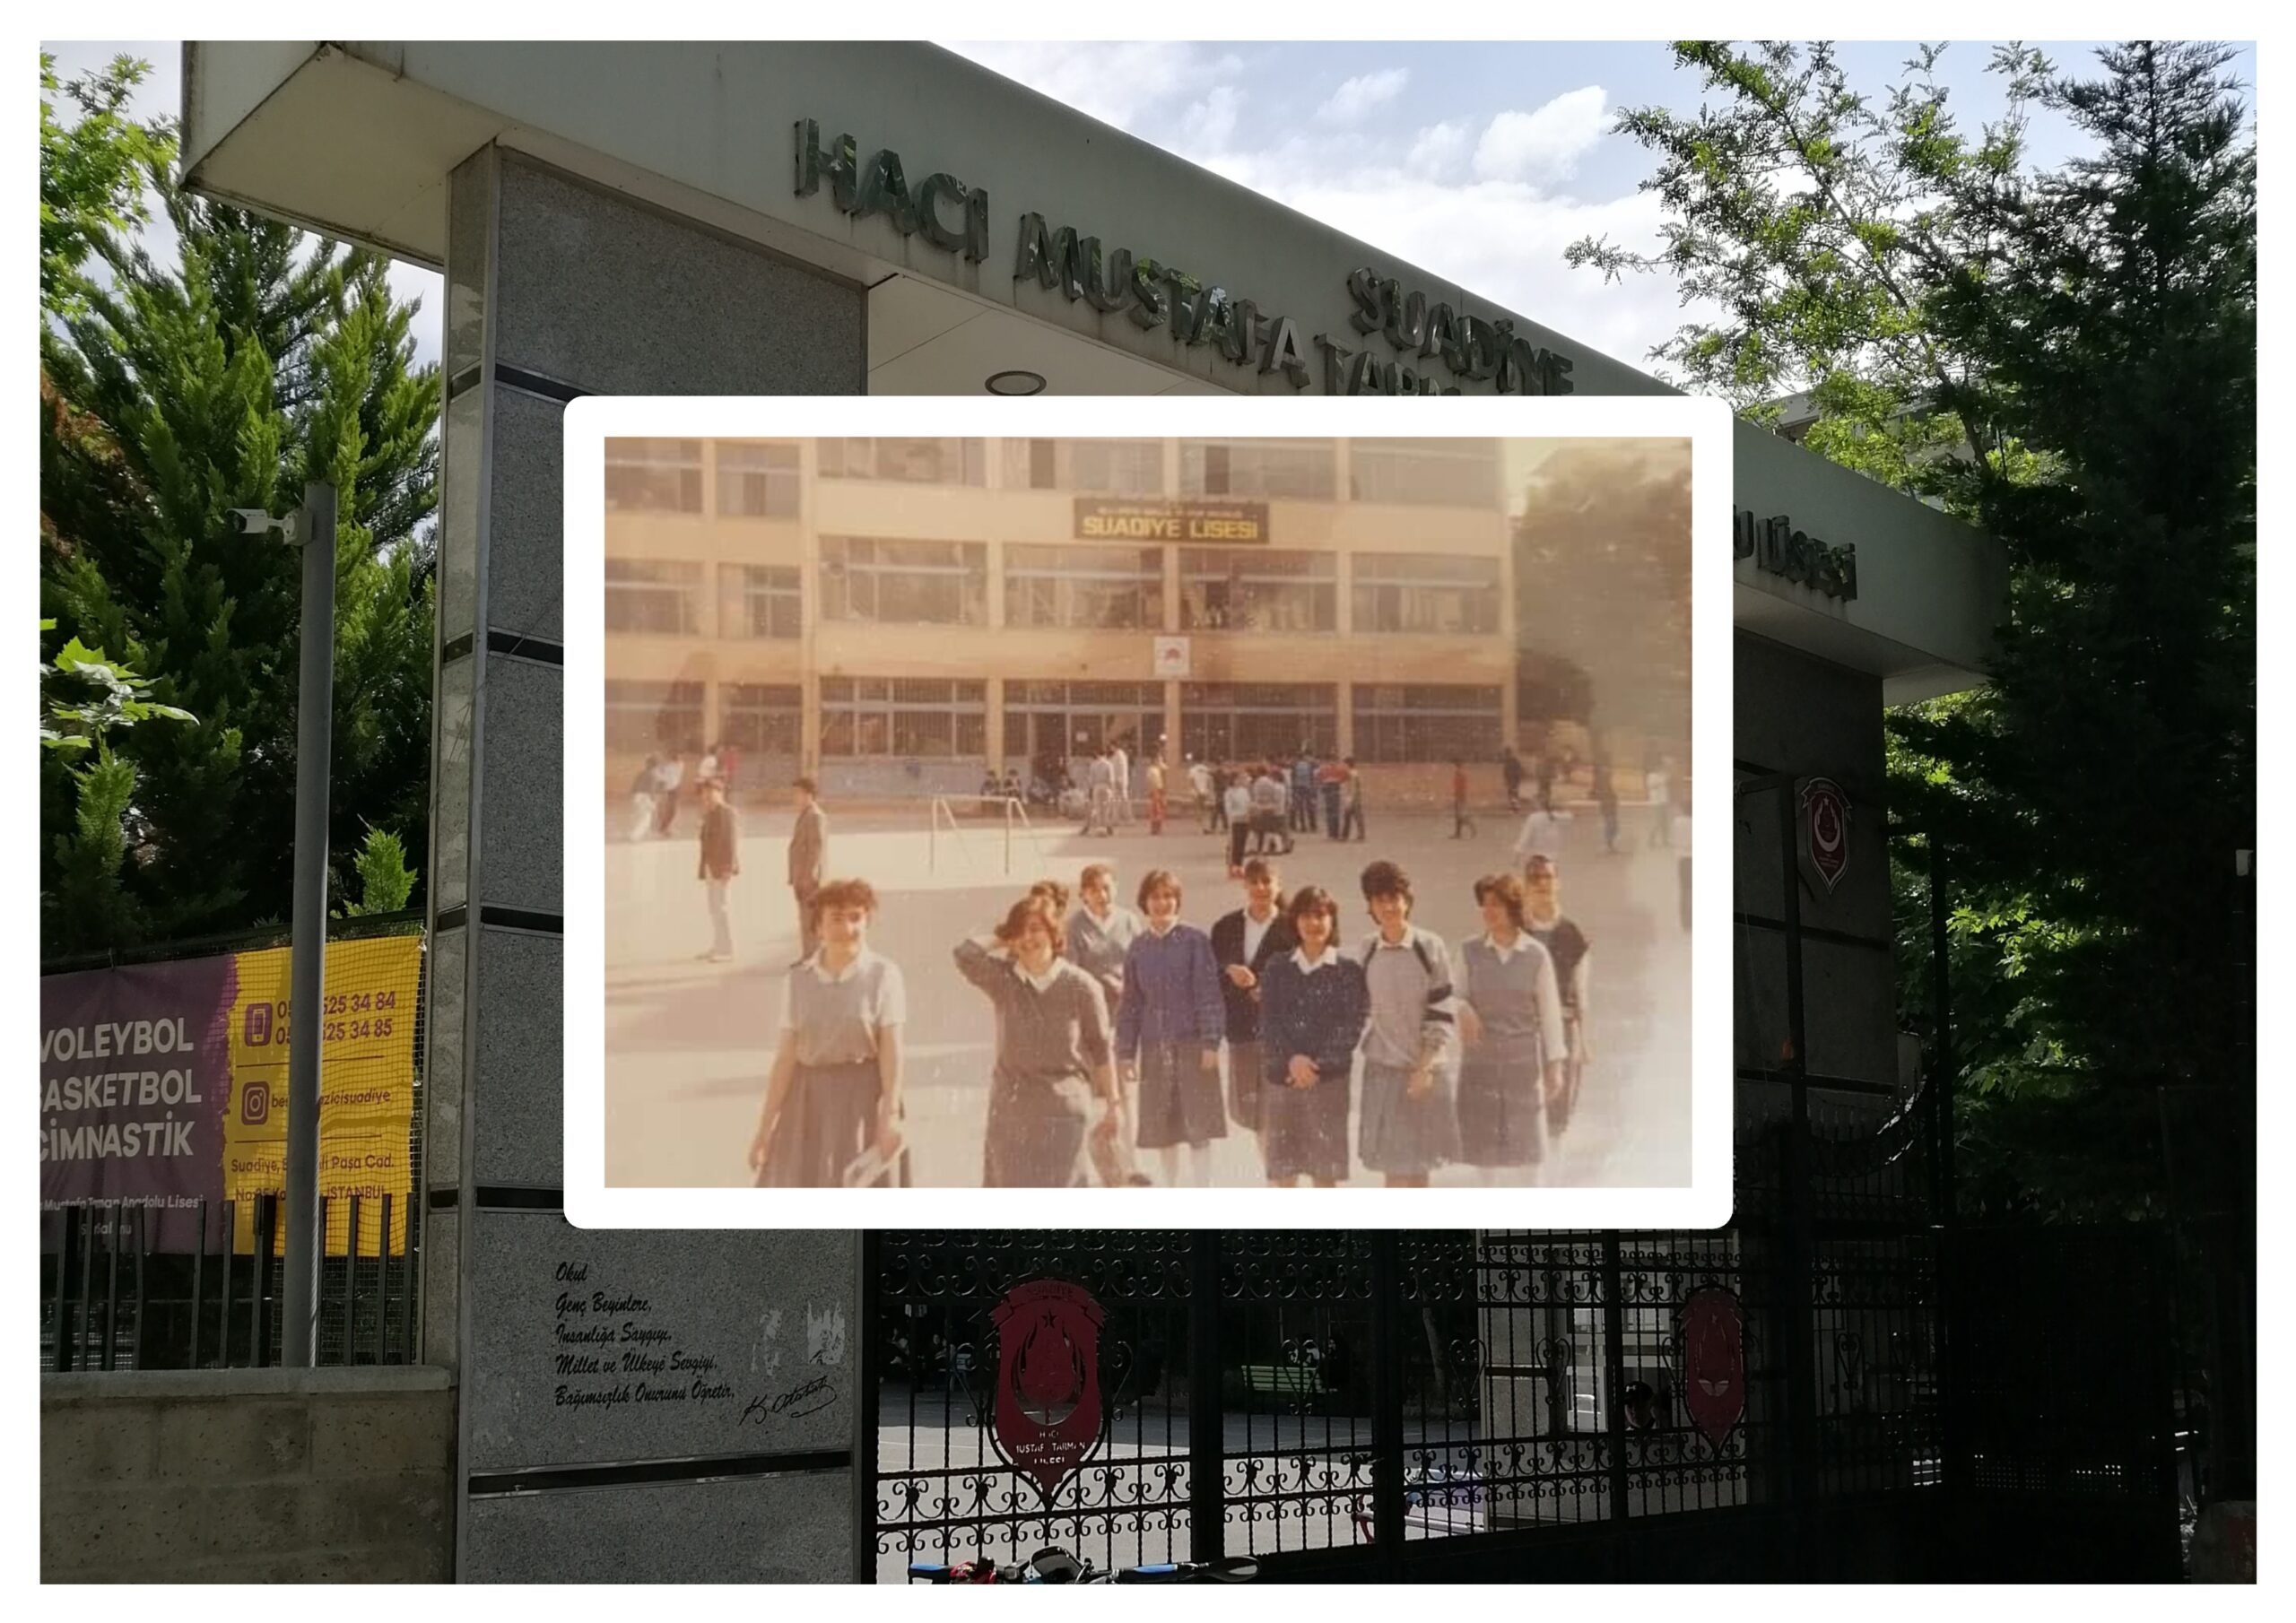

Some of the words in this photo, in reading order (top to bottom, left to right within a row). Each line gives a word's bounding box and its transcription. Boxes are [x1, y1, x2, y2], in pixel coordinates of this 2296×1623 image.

[794, 117, 988, 264] HACI
[1013, 212, 1310, 388] MUSTAFA
[352, 994, 370, 1012] 34
[375, 991, 396, 1011] 84
[40, 1017, 195, 1063] VOLEYBOL
[350, 1020, 370, 1039] 34
[374, 1018, 393, 1037] 85
[40, 1068, 202, 1113] ASKETBOL
[332, 1156, 361, 1173] Paşa
[365, 1153, 394, 1169] Cad.
[556, 1262, 588, 1281] Okul
[555, 1292, 587, 1319] Genç
[555, 1353, 599, 1376] Millet
[604, 1359, 617, 1373] ve
